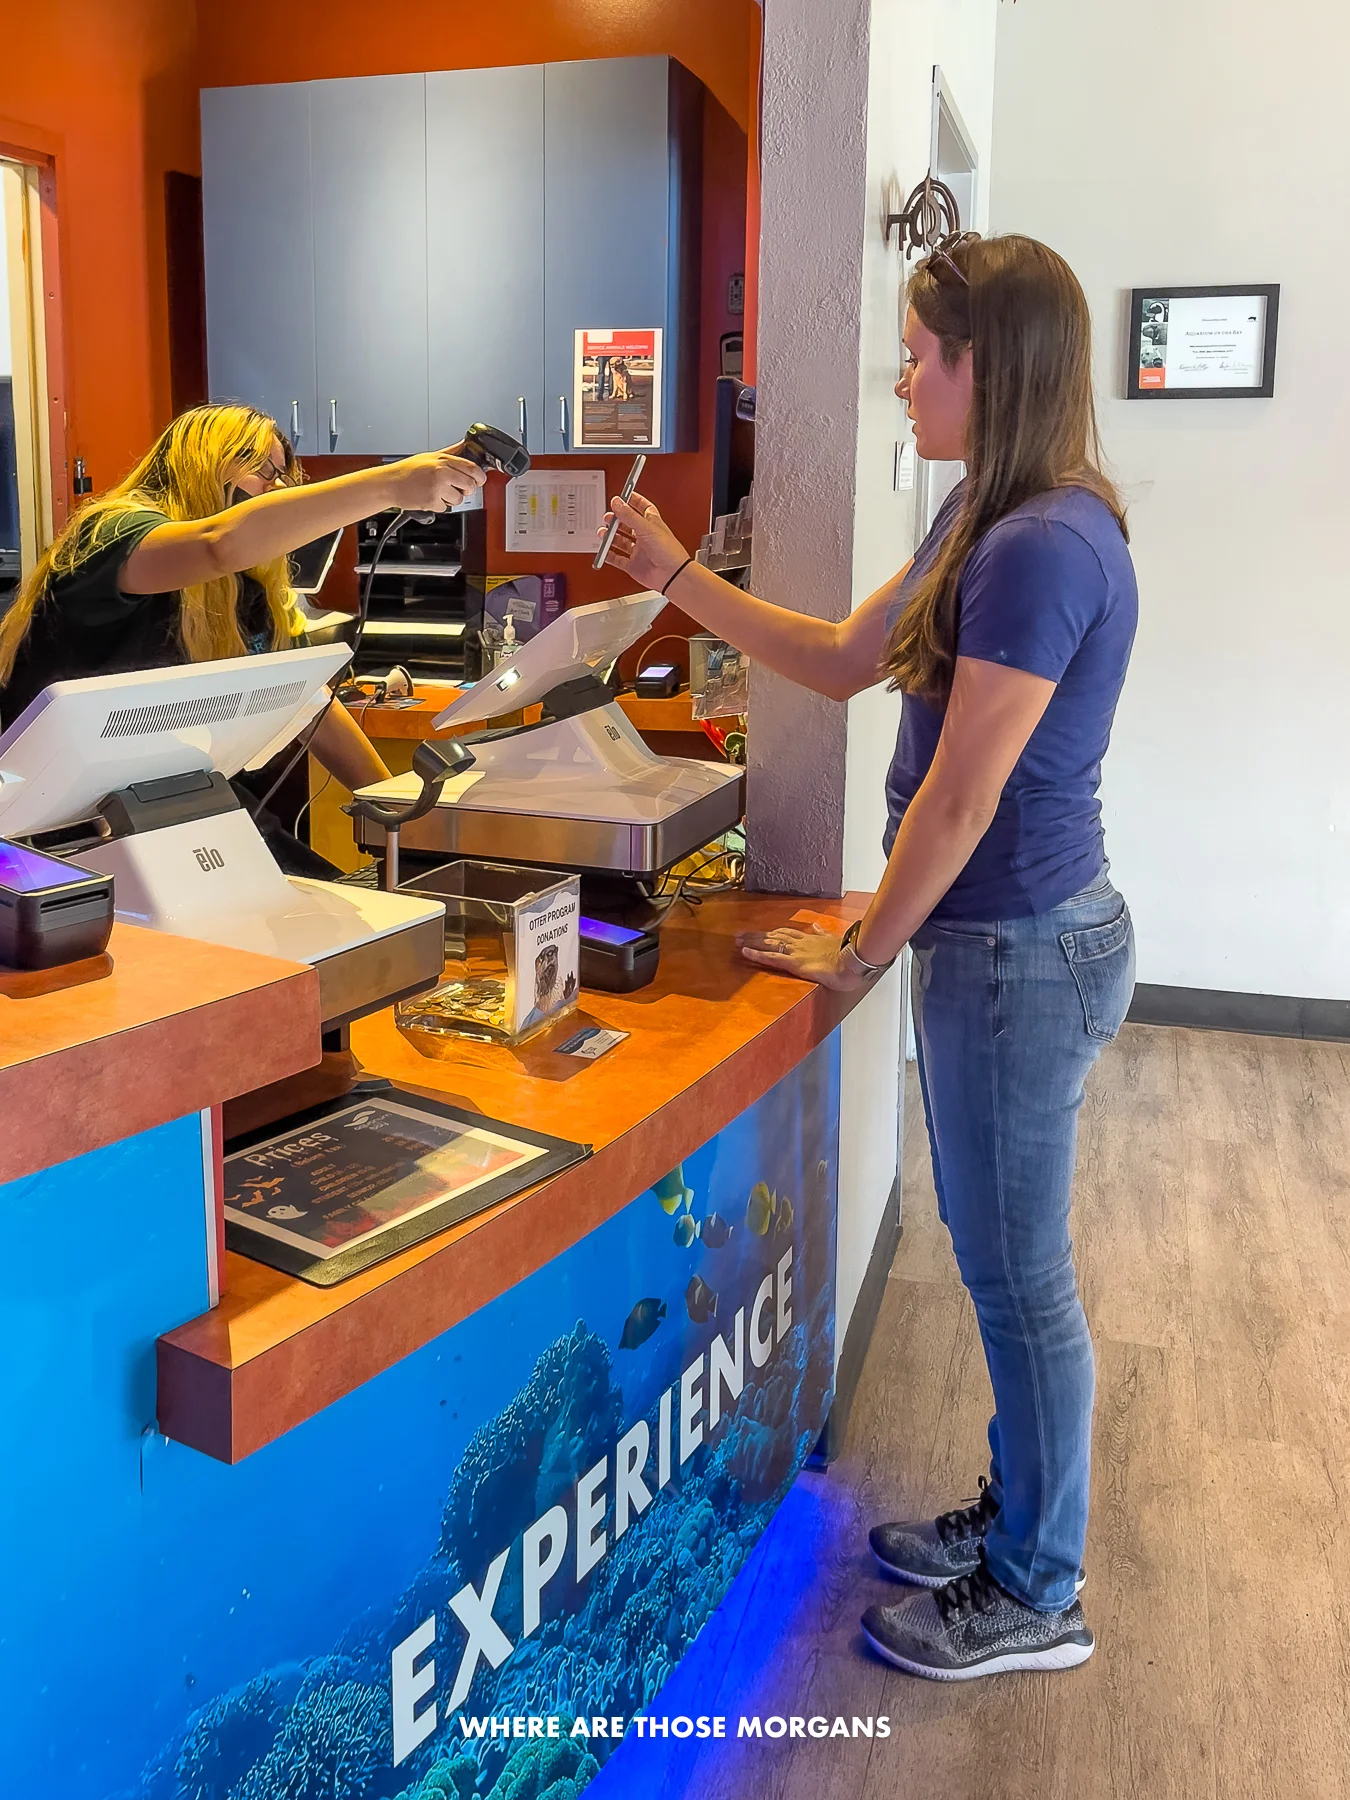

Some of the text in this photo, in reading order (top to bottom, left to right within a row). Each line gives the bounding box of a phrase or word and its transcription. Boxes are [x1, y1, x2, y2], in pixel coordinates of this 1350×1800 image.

[529, 902, 576, 931] OTTER PROGRAM
[536, 923, 568, 946] DONATIONS
[244, 1132, 339, 1169] Prices
[392, 1245, 794, 1768] EXPERIENCE
